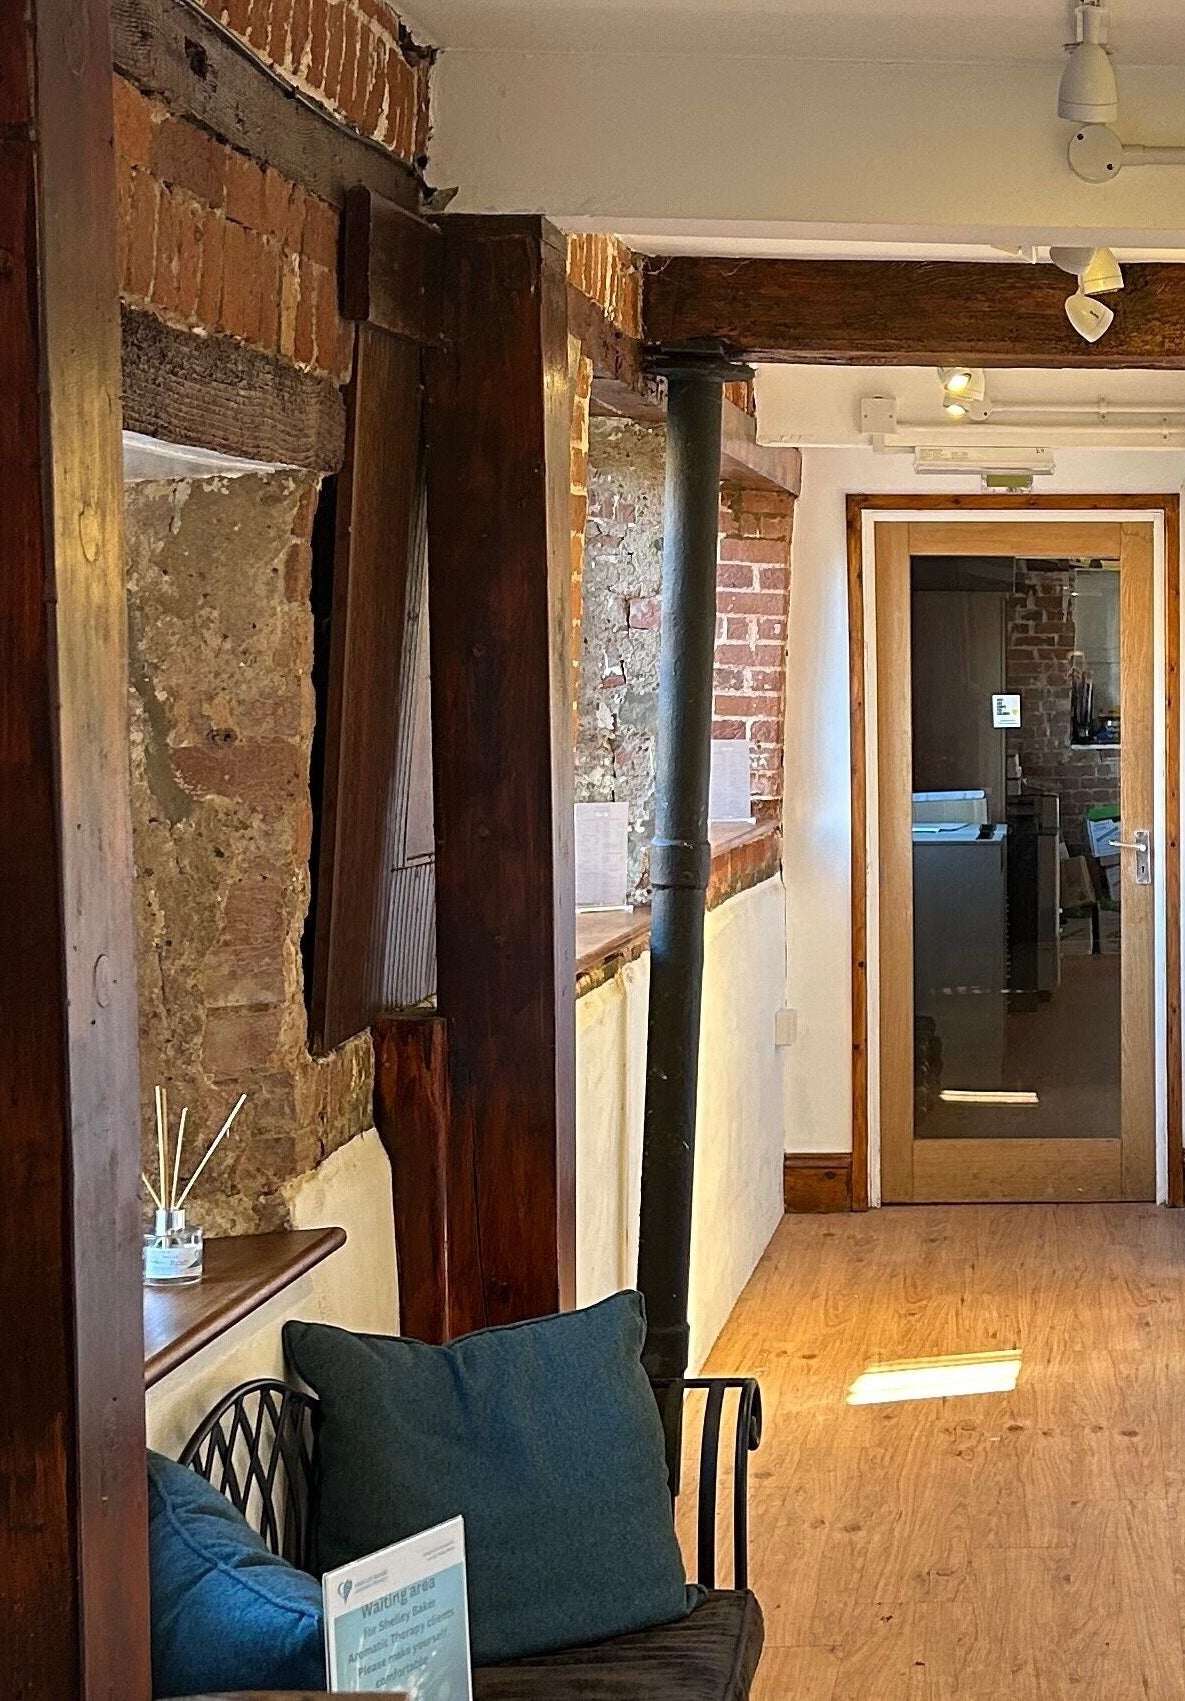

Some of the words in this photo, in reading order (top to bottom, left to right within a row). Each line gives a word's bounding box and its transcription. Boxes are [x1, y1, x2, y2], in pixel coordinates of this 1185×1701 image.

[360, 1590, 408, 1619] Waiting
[409, 1578, 436, 1598] area
[378, 1611, 412, 1632] Shelley
[412, 1599, 436, 1617] Baker
[347, 1638, 389, 1664] Aromatic
[390, 1624, 426, 1644] Therapy
[426, 1608, 456, 1628] clients
[358, 1658, 387, 1679] Please
[412, 1627, 448, 1655] yourself
[375, 1655, 429, 1688] comfortable
